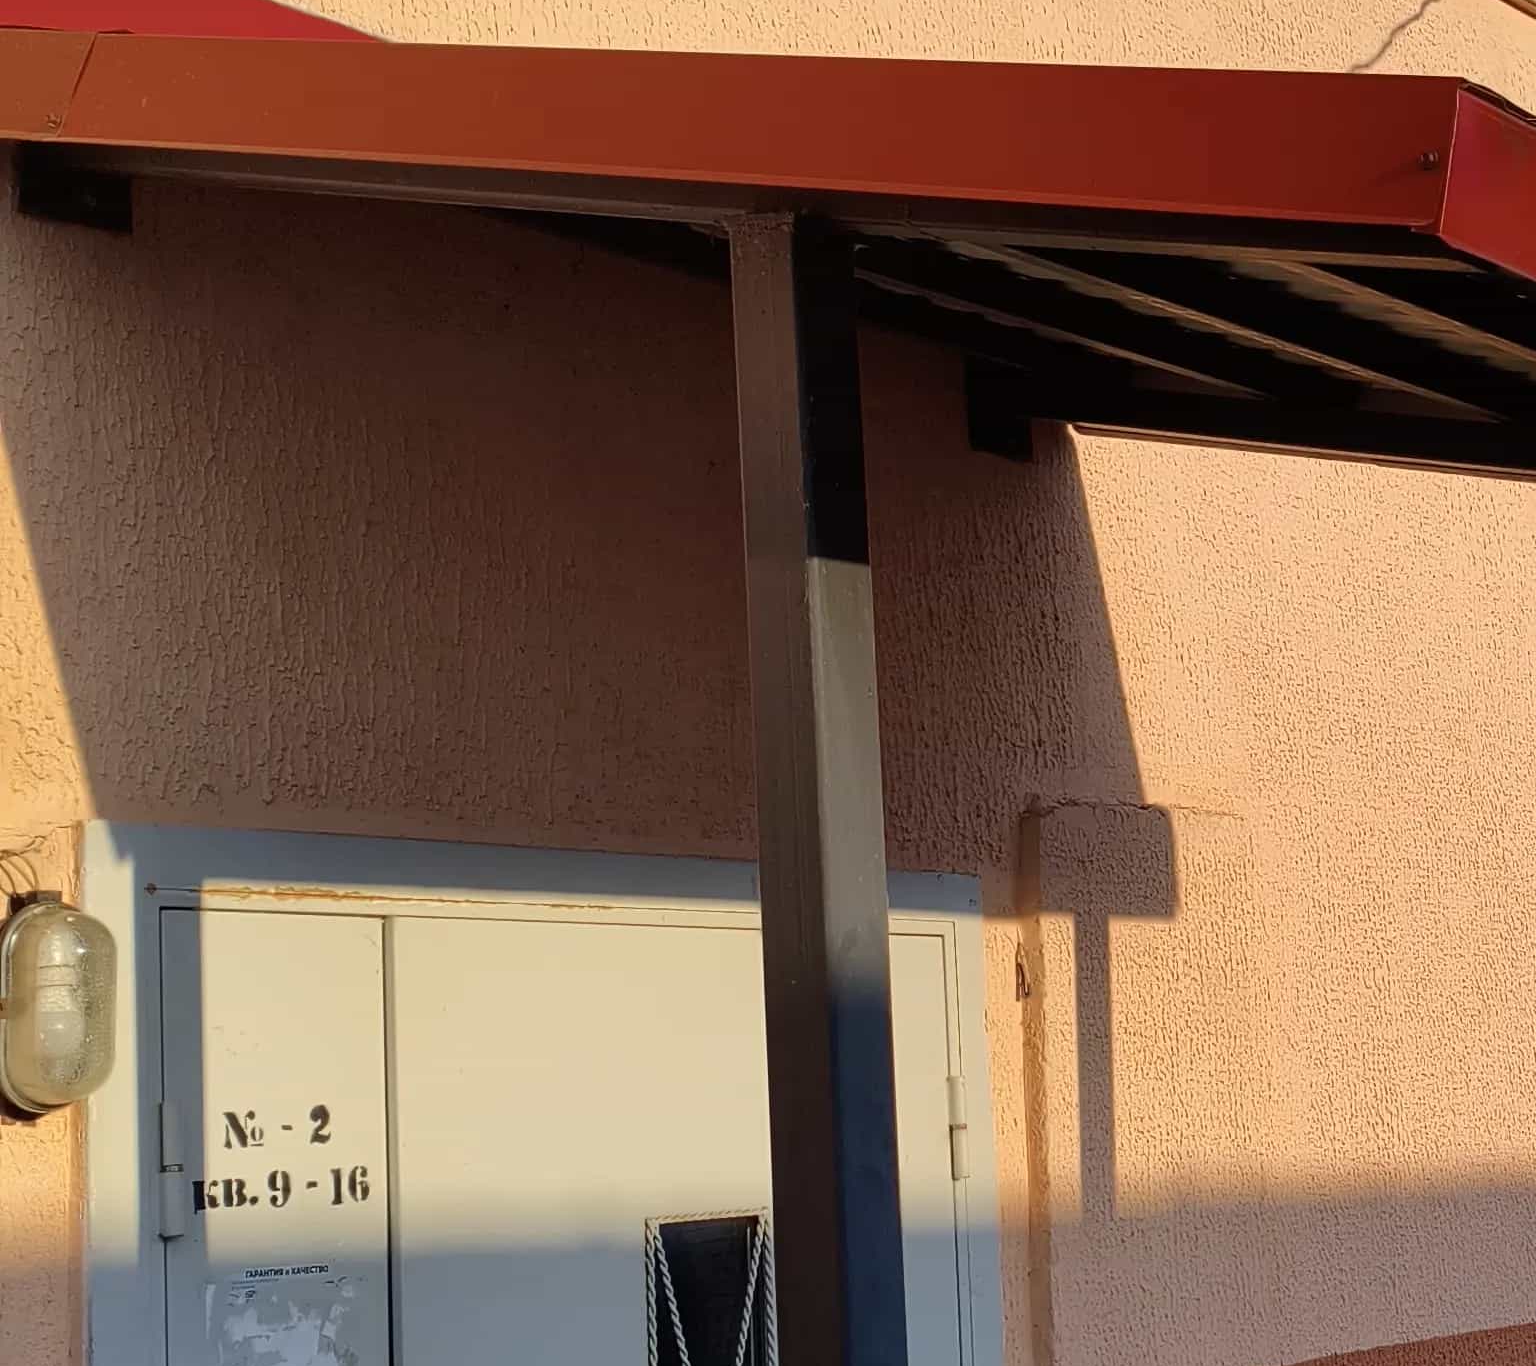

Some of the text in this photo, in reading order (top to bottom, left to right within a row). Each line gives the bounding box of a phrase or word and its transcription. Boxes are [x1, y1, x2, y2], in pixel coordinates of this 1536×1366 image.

[309, 1104, 332, 1145] 2
[245, 1267, 284, 1279] ГАРАНТИЯ
[291, 1264, 329, 1276] КАЧЕСТВО
